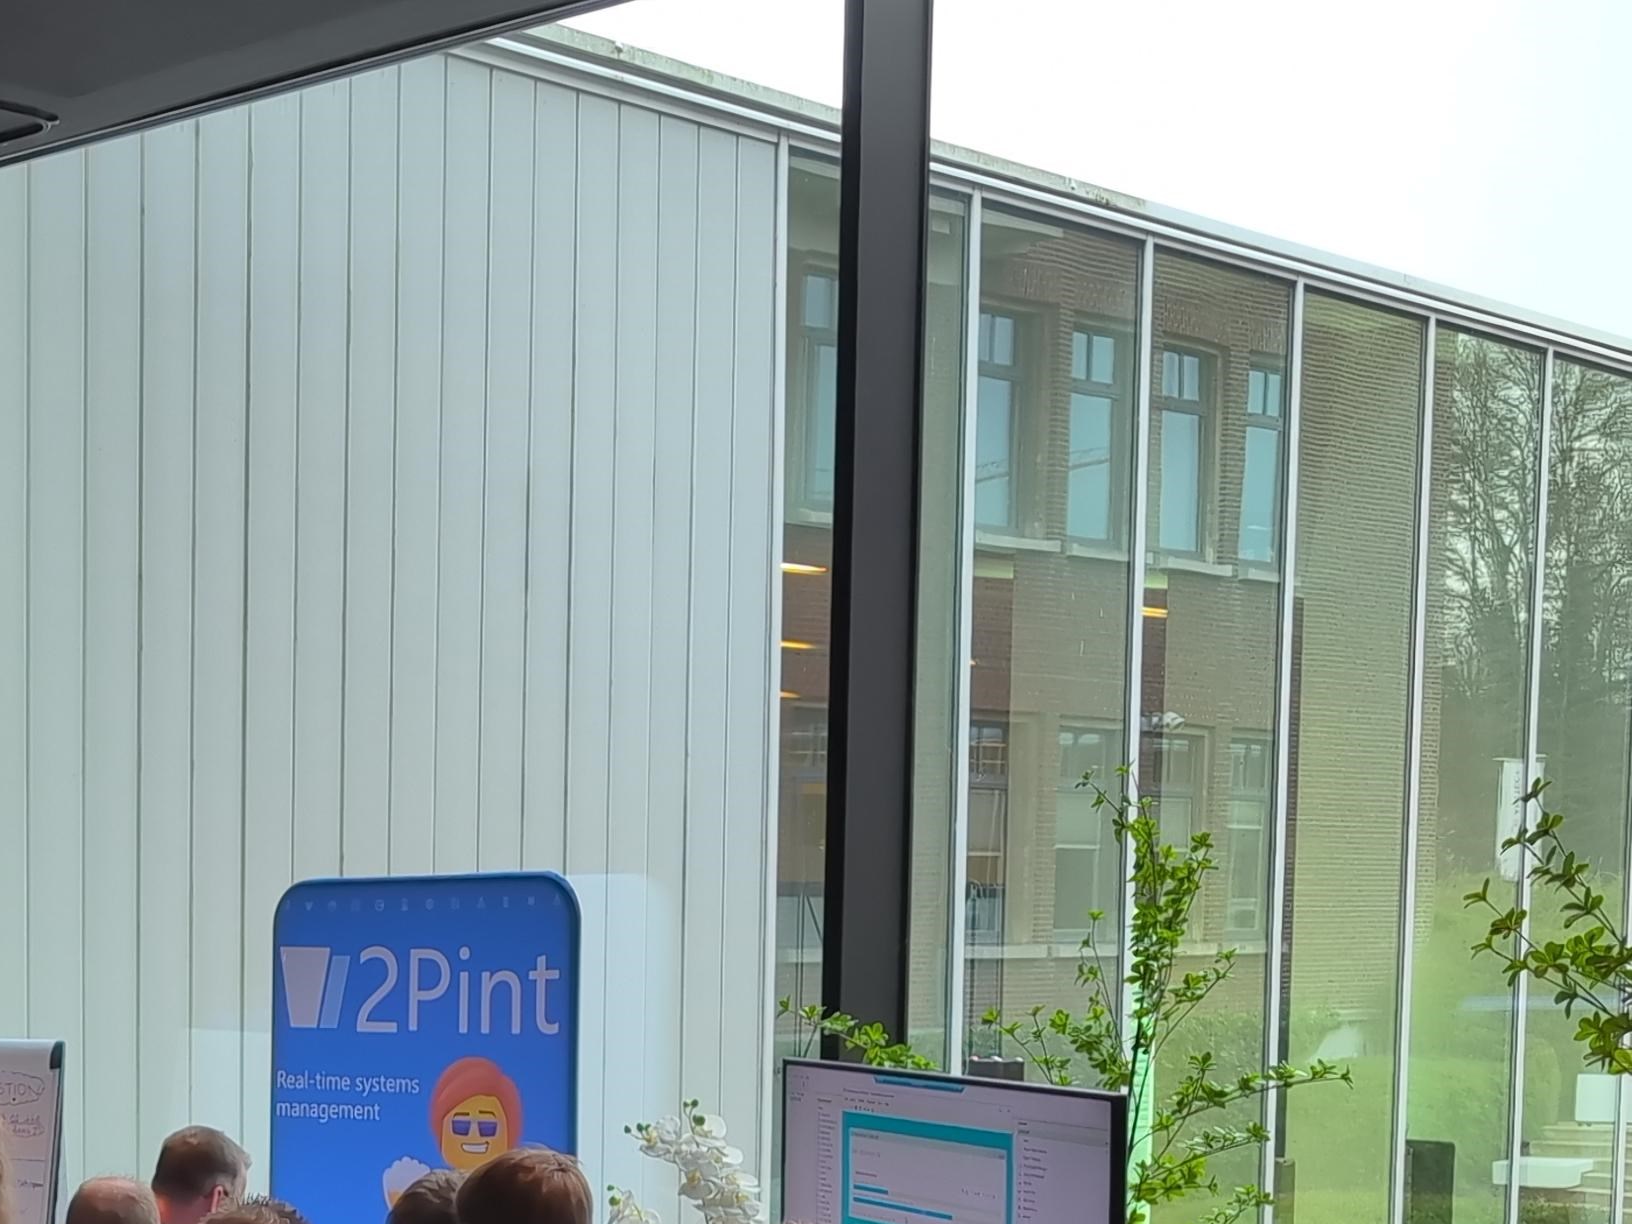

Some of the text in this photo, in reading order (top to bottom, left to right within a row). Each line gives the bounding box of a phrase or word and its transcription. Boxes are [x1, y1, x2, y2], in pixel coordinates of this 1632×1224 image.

[355, 945, 561, 1035] 2Pint
[276, 1070, 419, 1097] Real-time systems
[276, 1101, 380, 1124] management
